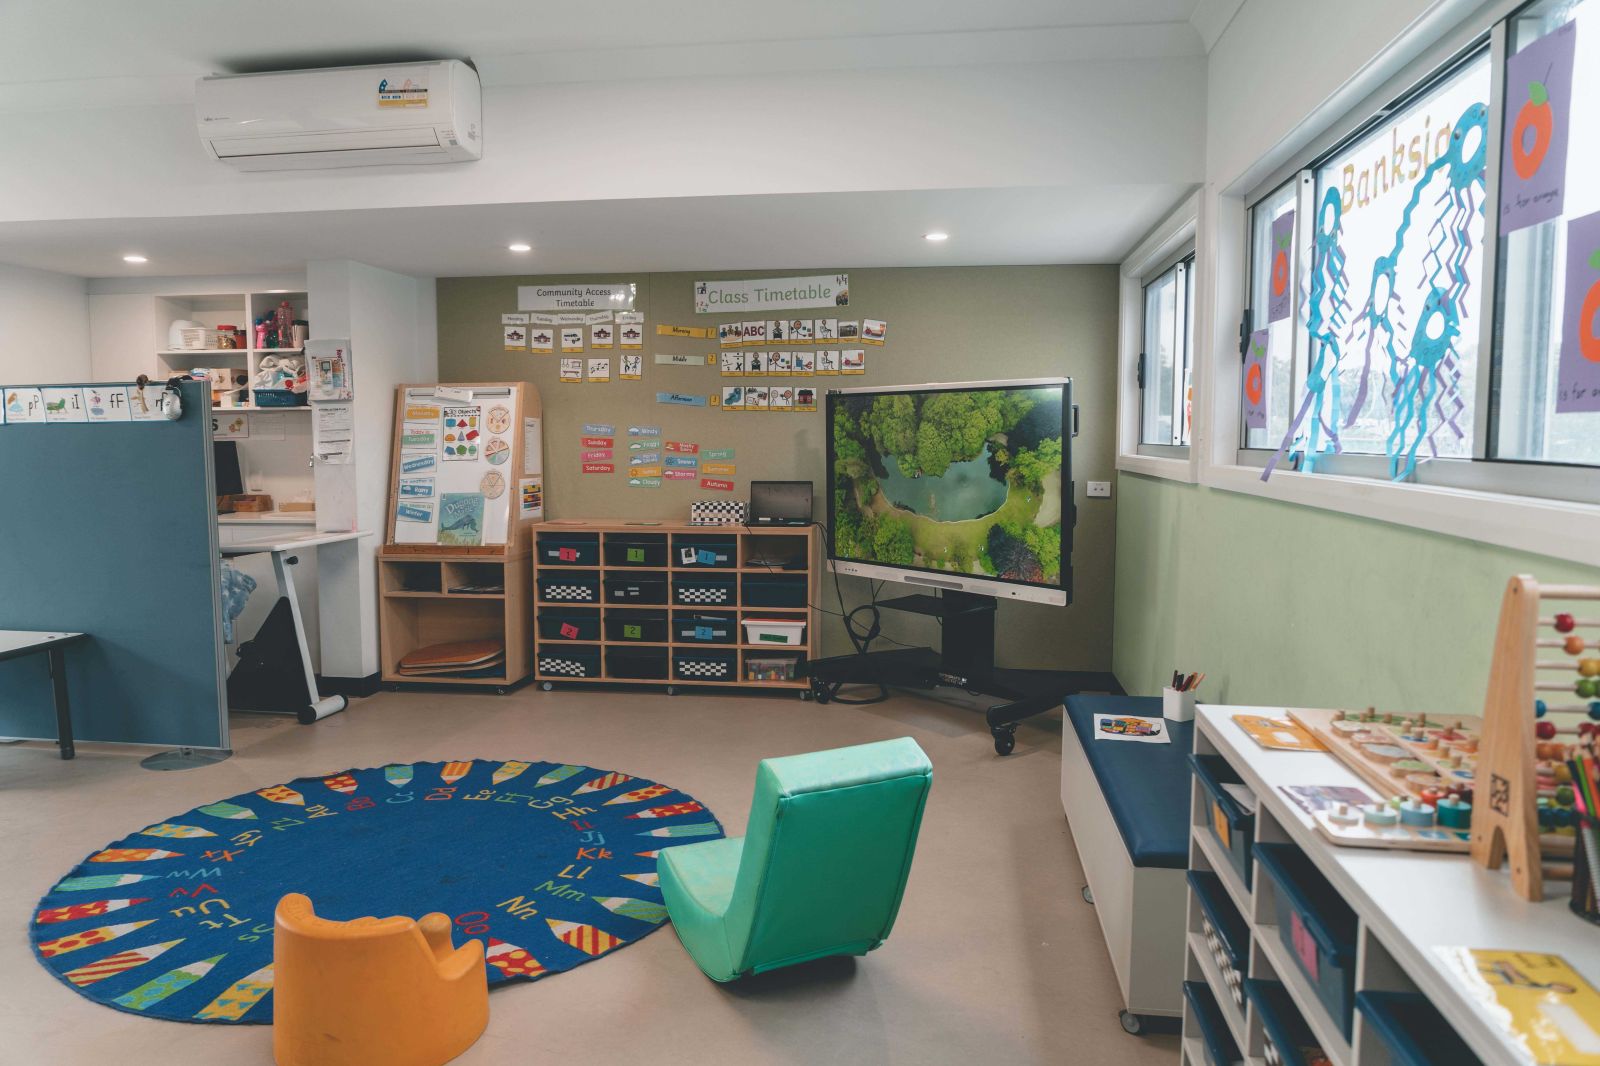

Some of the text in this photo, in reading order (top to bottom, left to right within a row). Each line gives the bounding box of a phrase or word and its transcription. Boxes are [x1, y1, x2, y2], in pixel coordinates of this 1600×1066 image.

[536, 288, 612, 298] Community Access
[708, 283, 832, 304] Class Timetable
[743, 326, 765, 336] ABC
[463, 789, 498, 802] Ee
[552, 804, 598, 821] Hh
[570, 819, 594, 832] Ii
[576, 847, 614, 860] Kk
[556, 864, 593, 880] Ll
[532, 880, 586, 902] Mm
[496, 895, 539, 920] Nn
[454, 911, 491, 936] Oo
